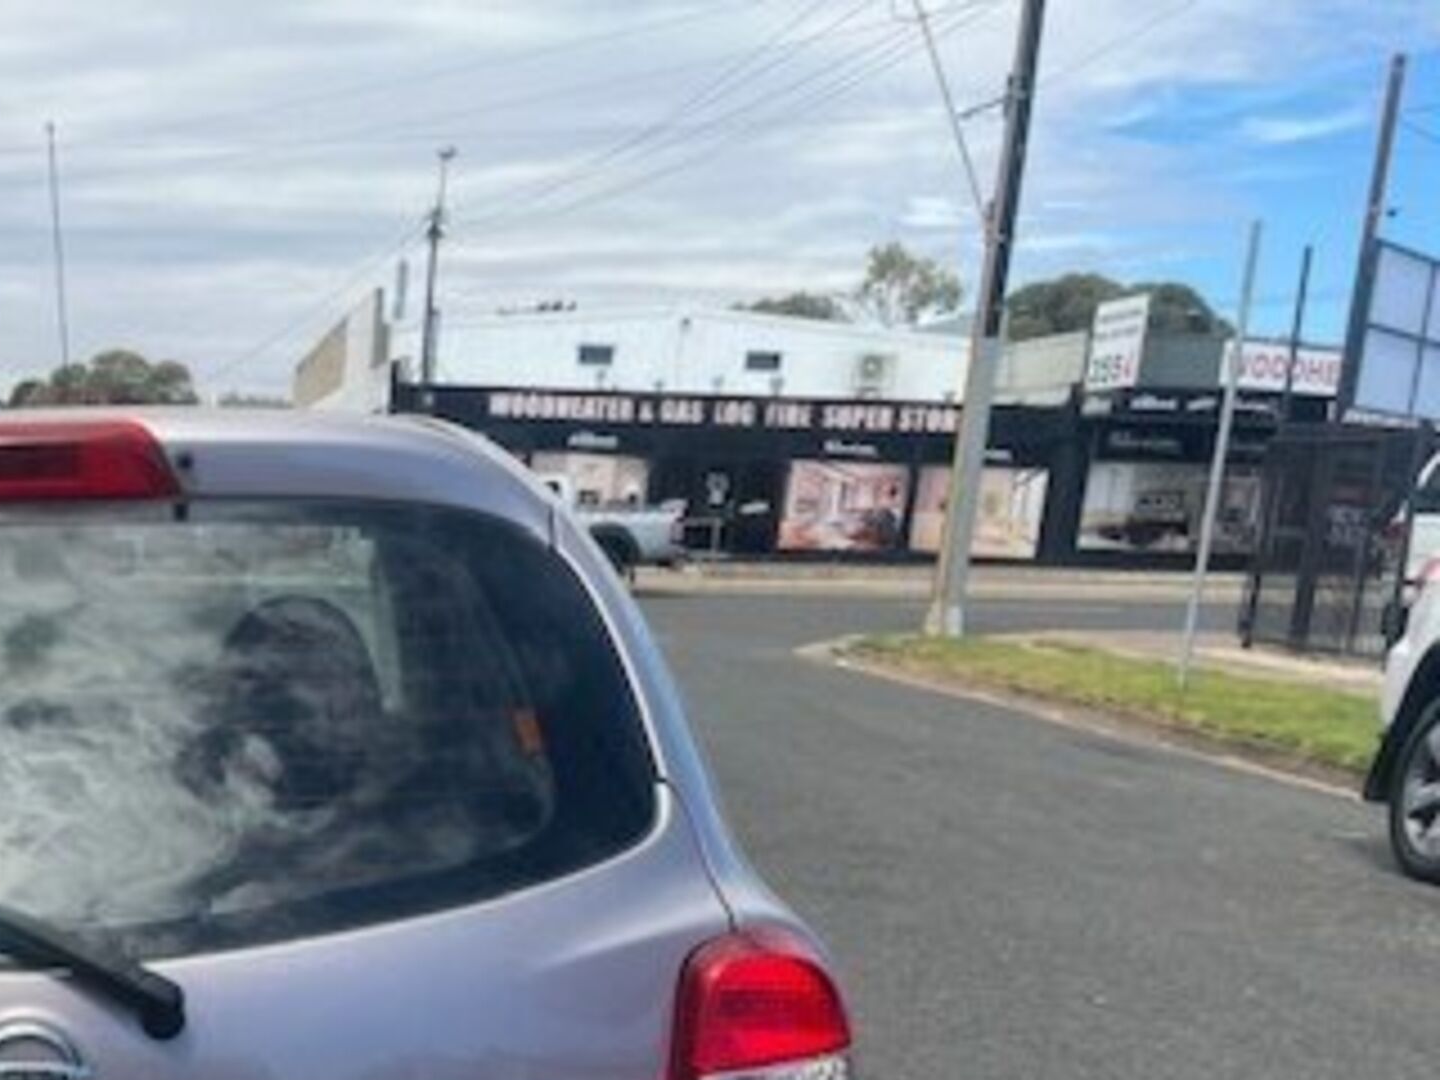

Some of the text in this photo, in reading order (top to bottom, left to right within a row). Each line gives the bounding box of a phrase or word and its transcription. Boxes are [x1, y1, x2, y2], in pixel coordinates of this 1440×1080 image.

[661, 400, 704, 425] GAS
[714, 401, 756, 427] LOG
[822, 404, 894, 431] SUPER
